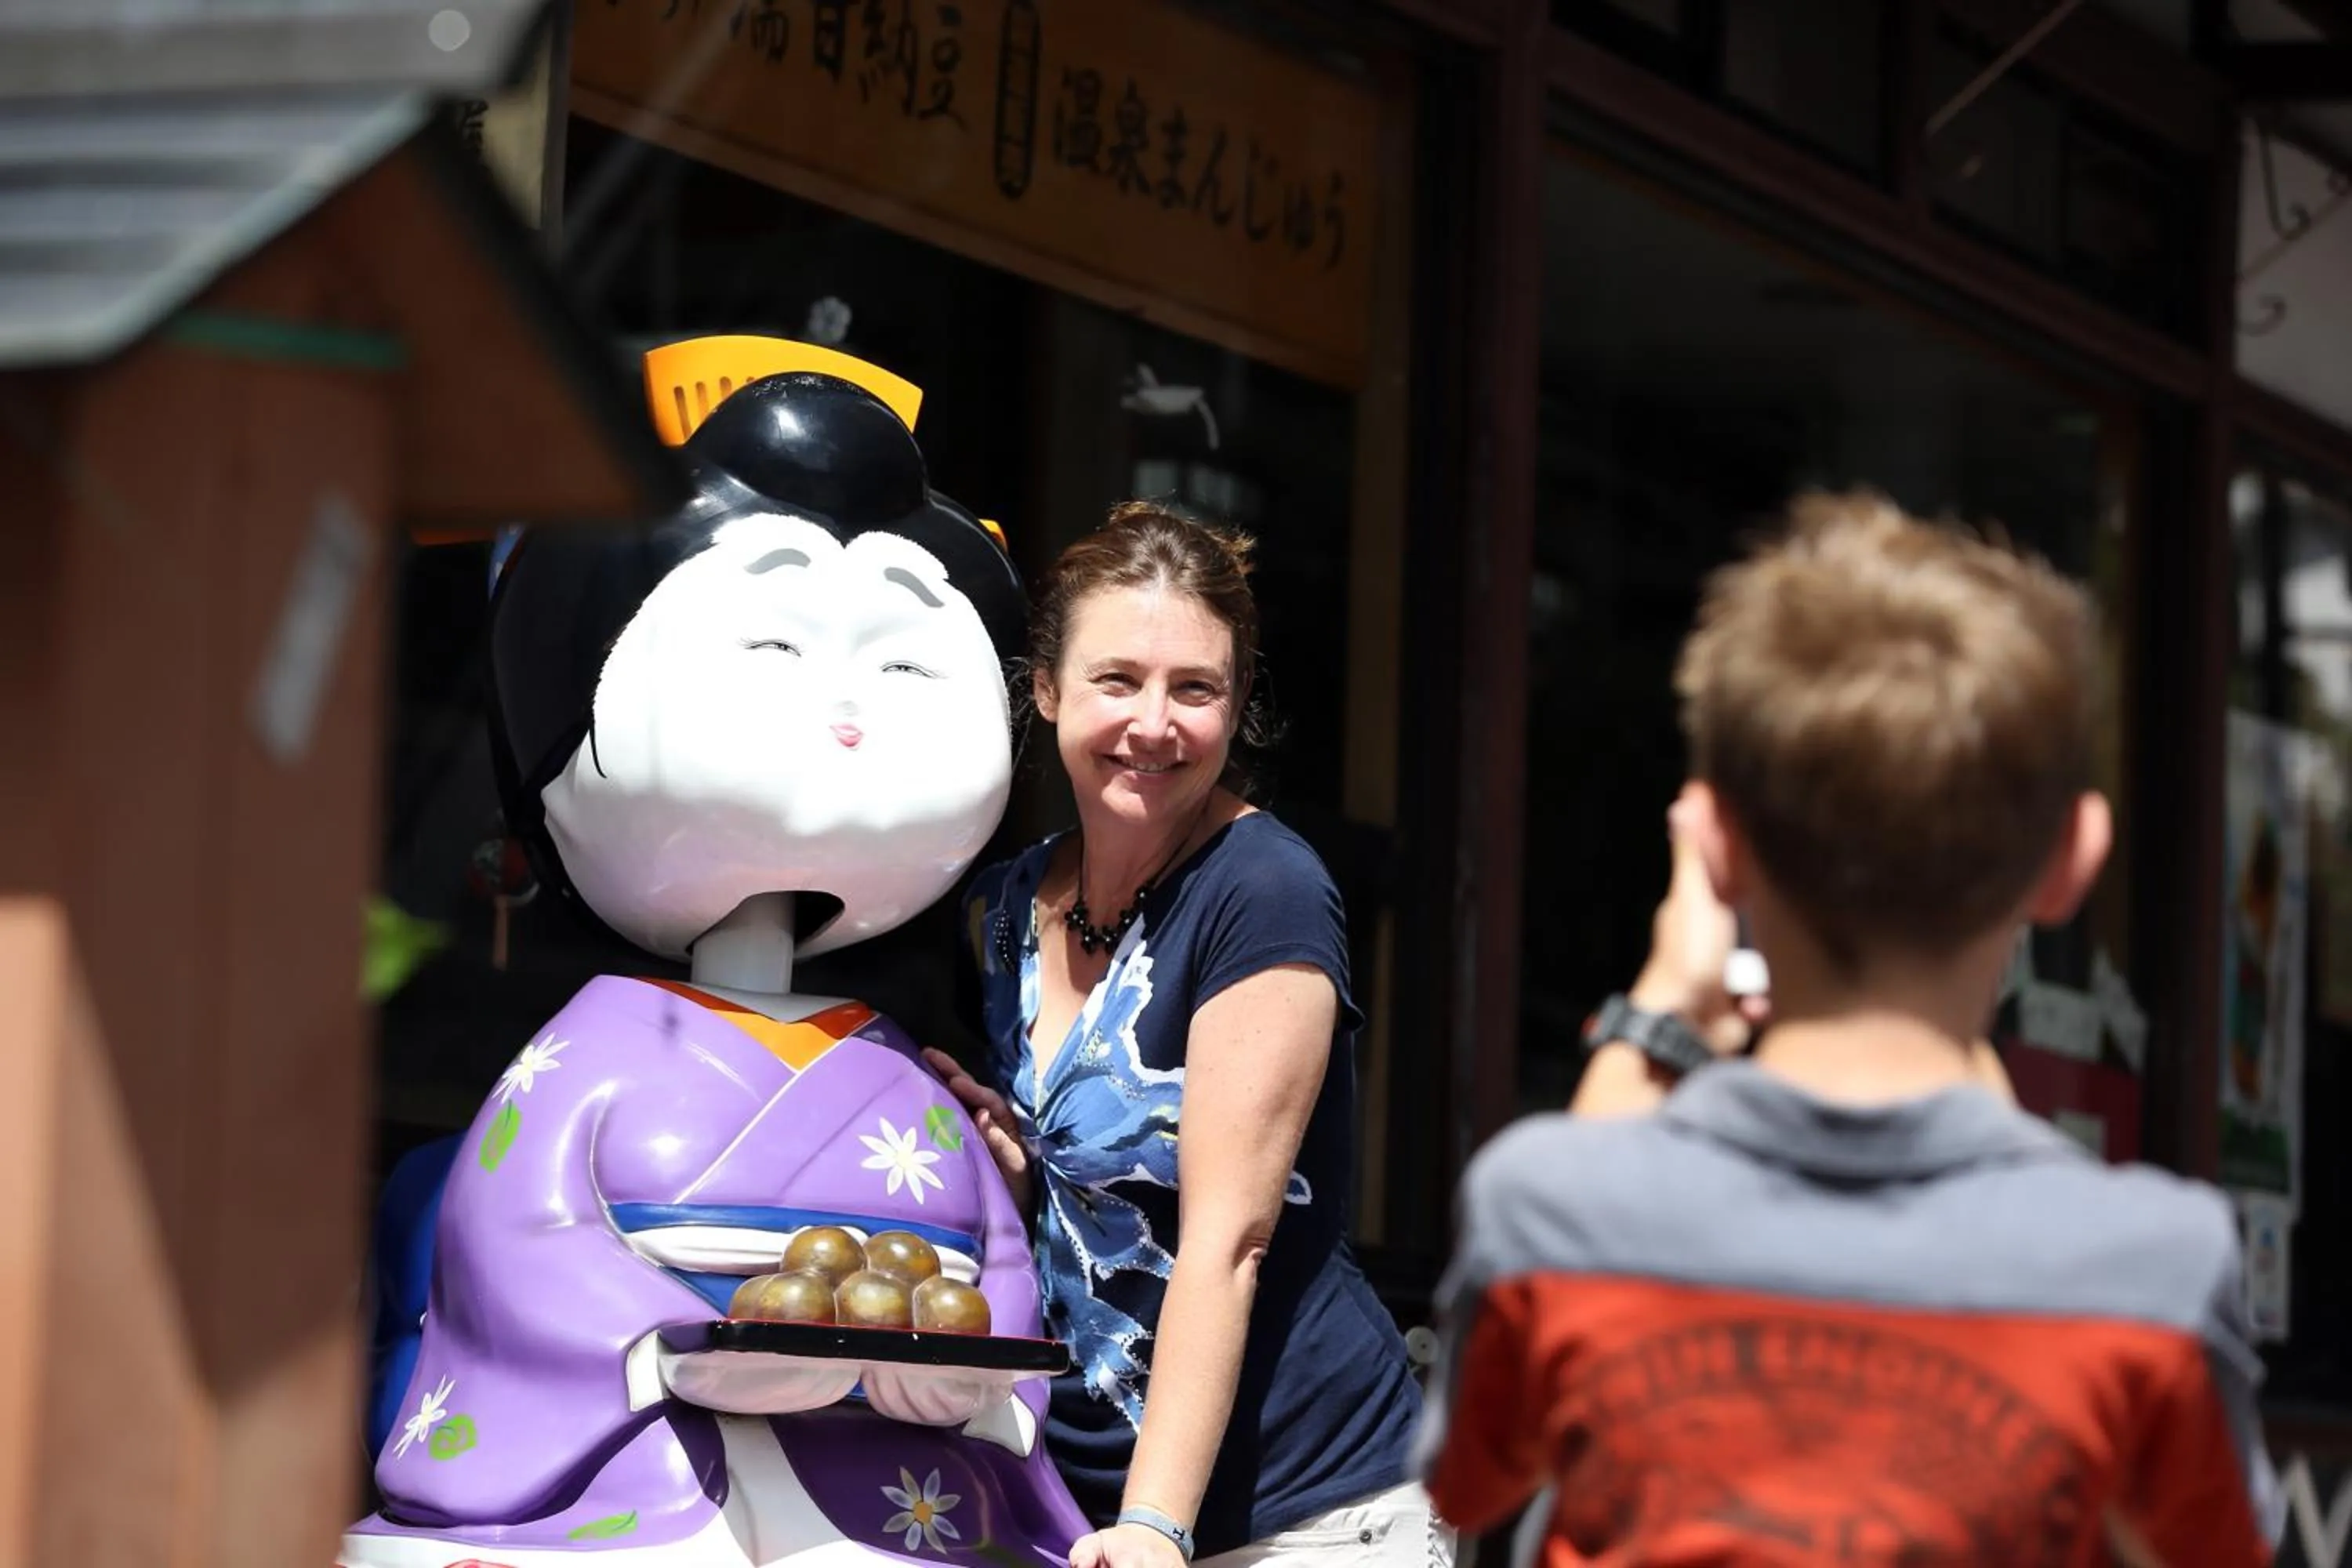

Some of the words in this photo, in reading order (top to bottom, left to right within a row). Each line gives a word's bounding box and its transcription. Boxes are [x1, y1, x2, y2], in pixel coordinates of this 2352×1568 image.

[1053, 64, 1346, 272] 温泉まんじゅう
